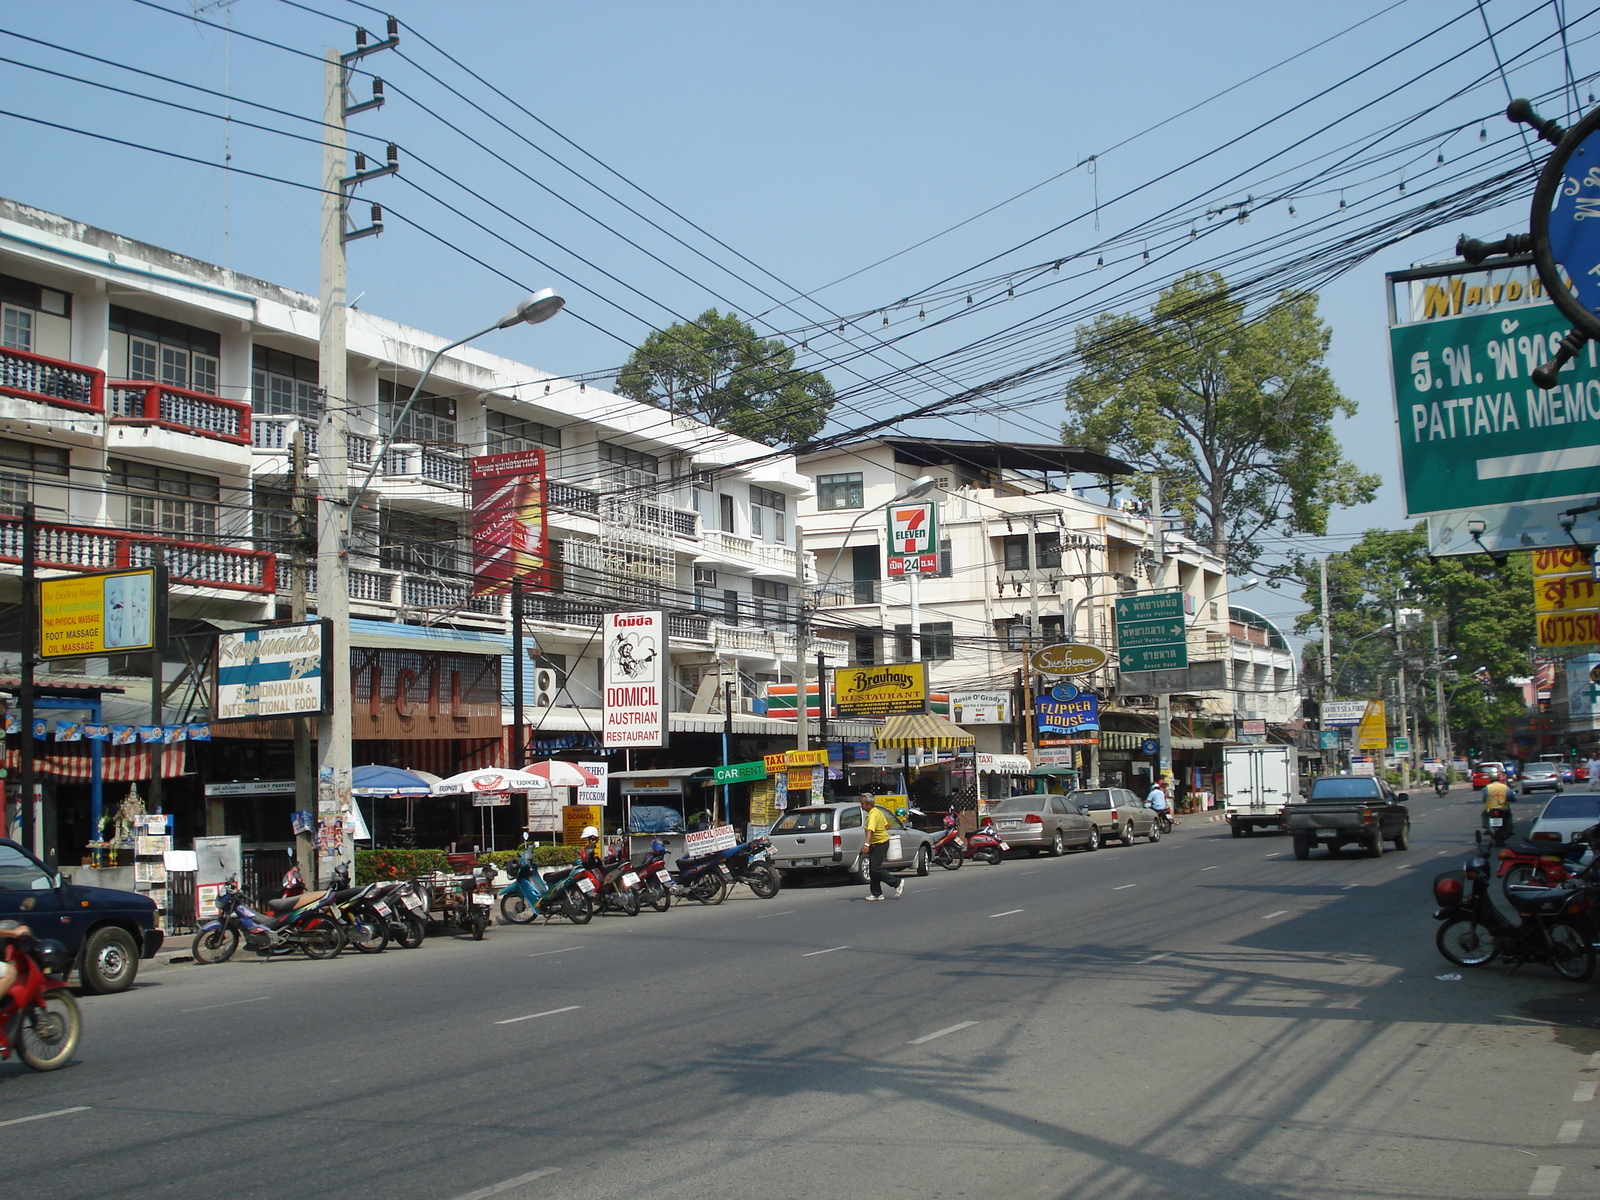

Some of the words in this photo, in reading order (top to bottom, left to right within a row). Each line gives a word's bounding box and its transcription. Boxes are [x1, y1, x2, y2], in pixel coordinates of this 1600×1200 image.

[1412, 392, 1520, 443] PATTAYA
[475, 526, 492, 543] Red
[896, 508, 925, 552] 7
[905, 558, 919, 572] 24
[44, 619, 54, 627] THAI
[55, 617, 76, 625] PHYSICAL
[78, 614, 100, 623] MASSAGE
[46, 632, 63, 640] FOOT
[66, 628, 99, 639] MASSAGE
[49, 645, 59, 653] OIL
[62, 642, 94, 652] MASSAGE
[848, 668, 914, 692] Brauhaus
[237, 682, 304, 699] SCANDINAVIAN
[306, 684, 313, 694] &
[350, 667, 470, 717] ICIL
[608, 686, 658, 708] DOMICIL
[842, 691, 920, 701] RESTAURANT
[953, 695, 972, 704] Rosie
[973, 694, 1007, 703] O'Grady's
[223, 700, 290, 716] INTERNATIONAL
[295, 697, 317, 710] FOOD
[1041, 701, 1091, 715] FLIPPER
[609, 712, 658, 725] AUSTRIAN
[1046, 714, 1085, 727] HOUSE
[607, 731, 659, 742] RESTAURANT
[766, 755, 785, 765] TAXI
[978, 756, 992, 764] TAXI
[718, 768, 738, 780] CAR
[740, 766, 763, 777] RENT
[579, 792, 605, 801] РУССКОМ
[687, 830, 714, 842] DOMICIL
[715, 825, 734, 836] DOMICIL
